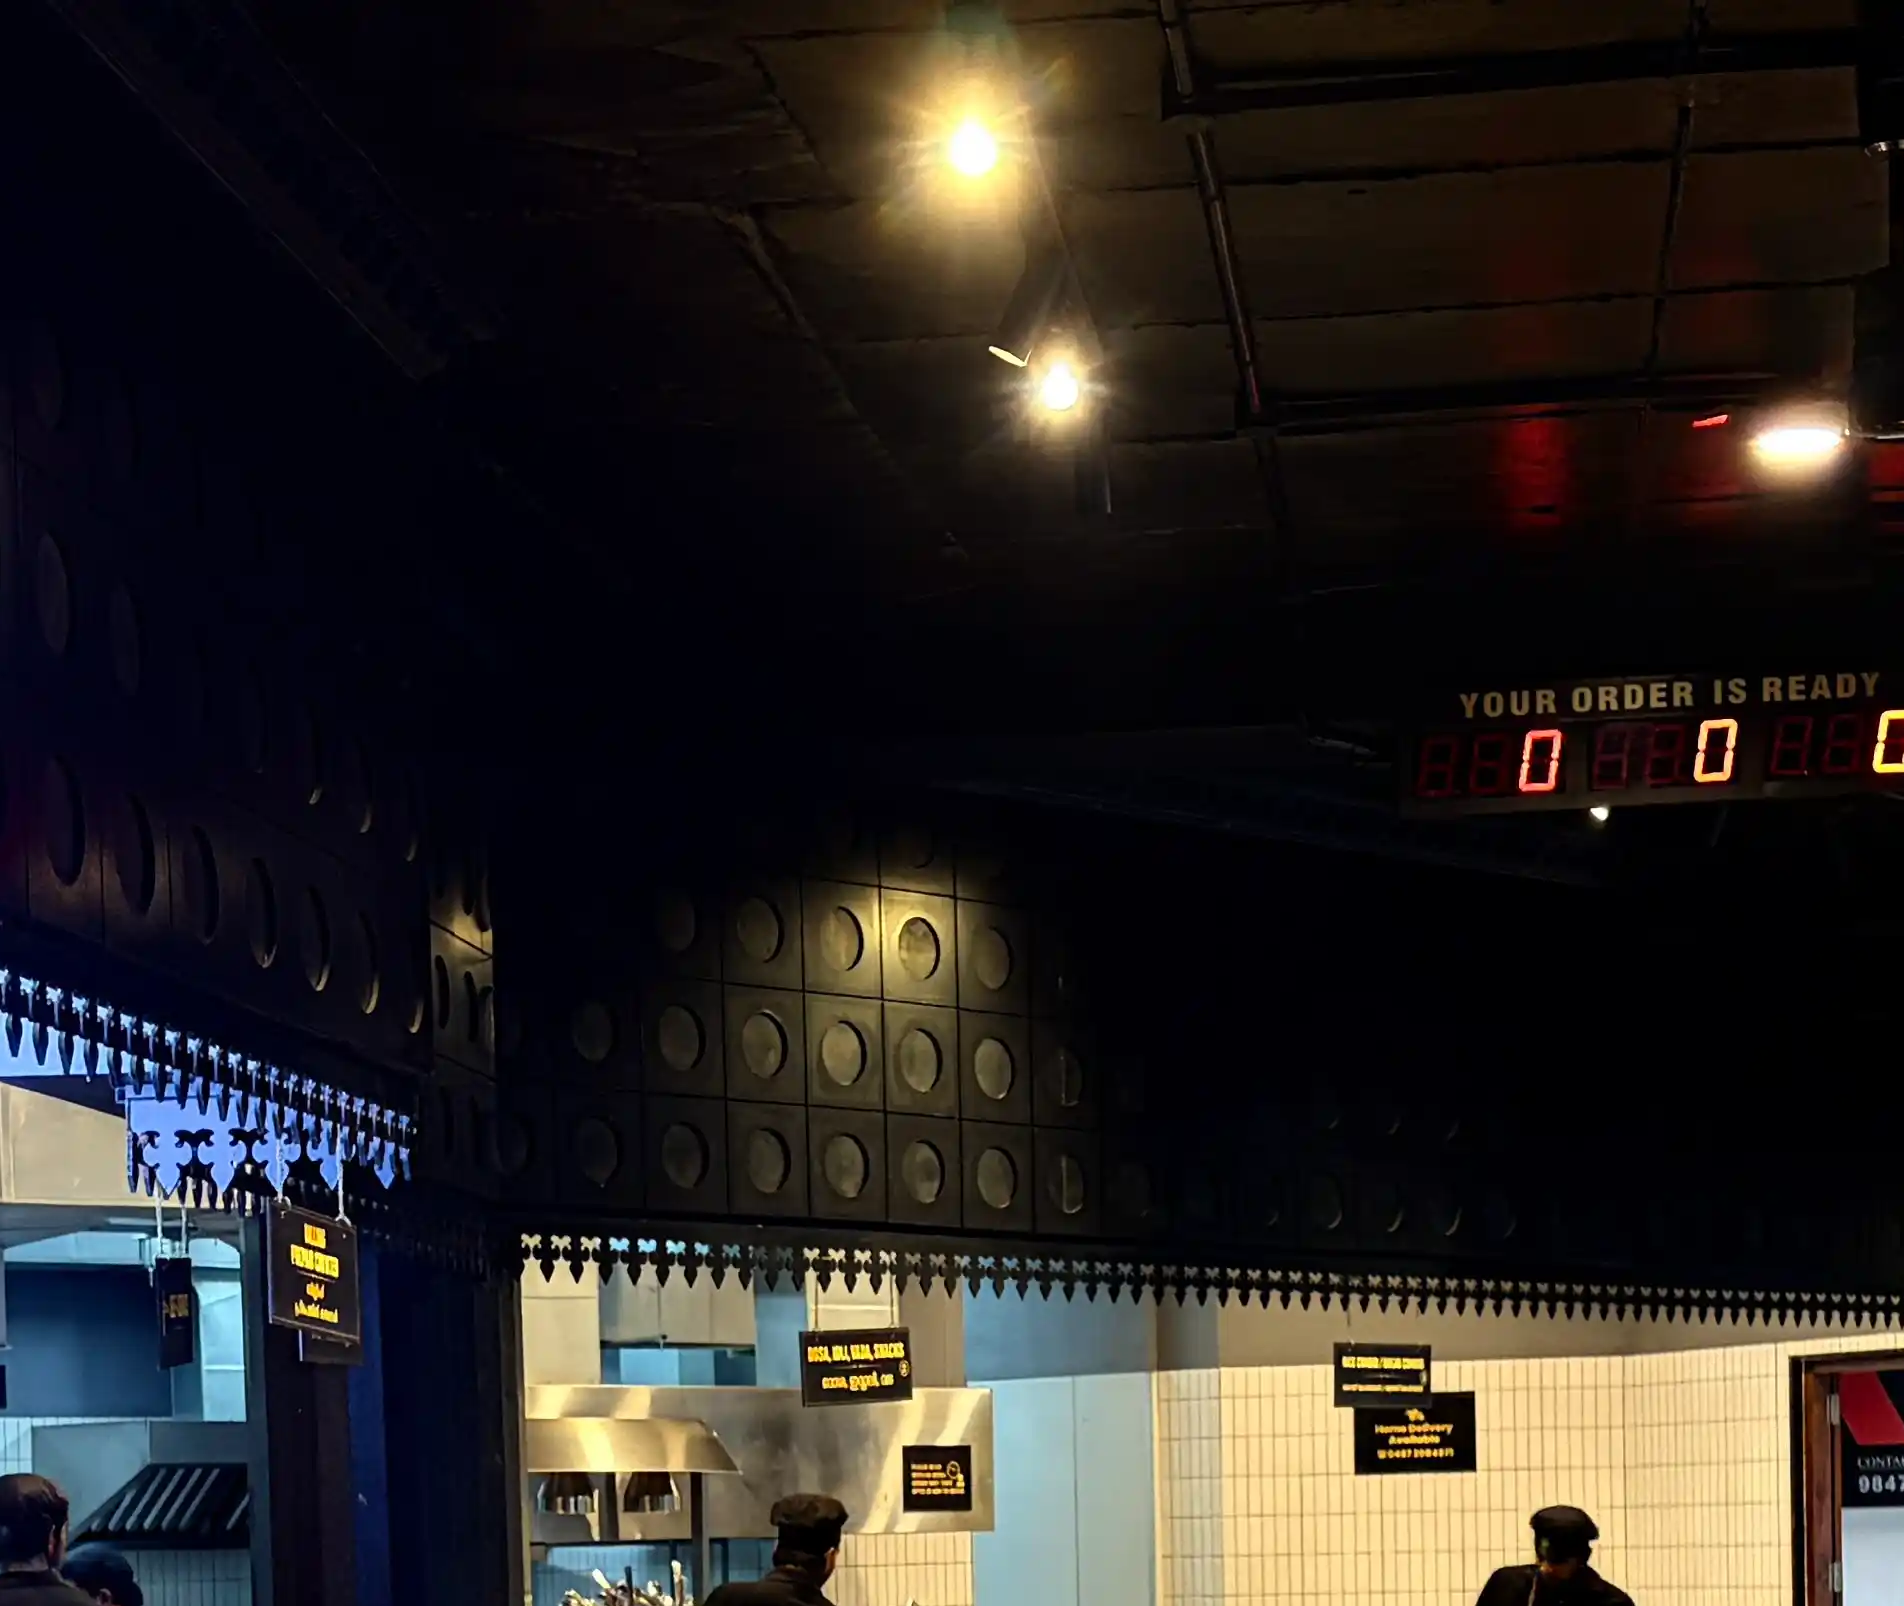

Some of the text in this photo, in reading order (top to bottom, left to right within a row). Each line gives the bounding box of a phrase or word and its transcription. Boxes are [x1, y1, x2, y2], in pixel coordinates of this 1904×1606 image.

[1459, 671, 1880, 719] YOUR ORDER IS READY
